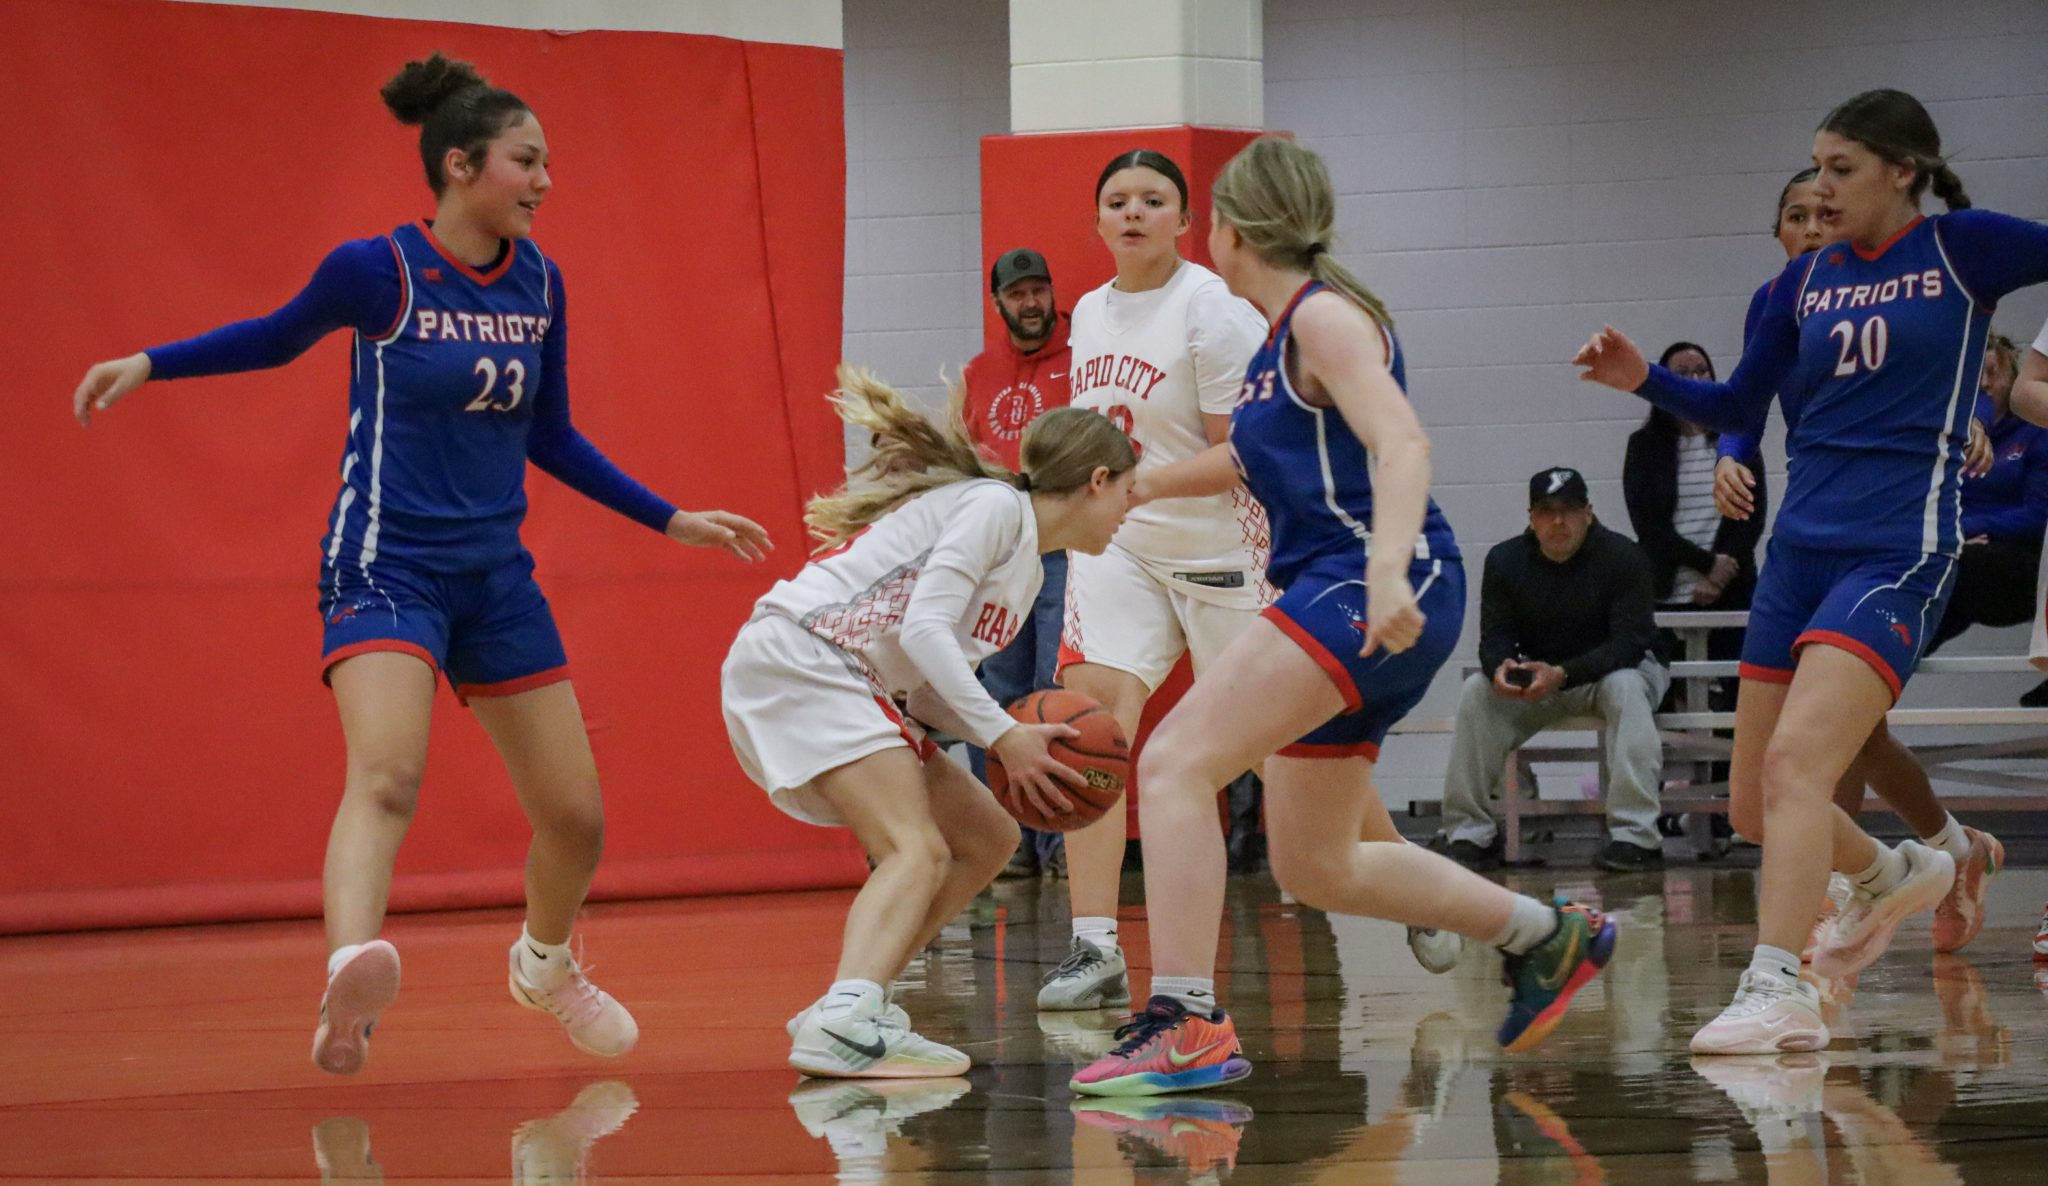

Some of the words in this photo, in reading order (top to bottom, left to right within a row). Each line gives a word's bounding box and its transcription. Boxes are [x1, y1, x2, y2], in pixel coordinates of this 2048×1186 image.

[1803, 268, 1942, 318] PATRIOTS
[417, 309, 549, 343] PATRIOTS
[1829, 315, 1888, 377] 20
[464, 356, 526, 412] 23
[1070, 354, 1114, 400] APID
[1115, 355, 1167, 400] CITY
